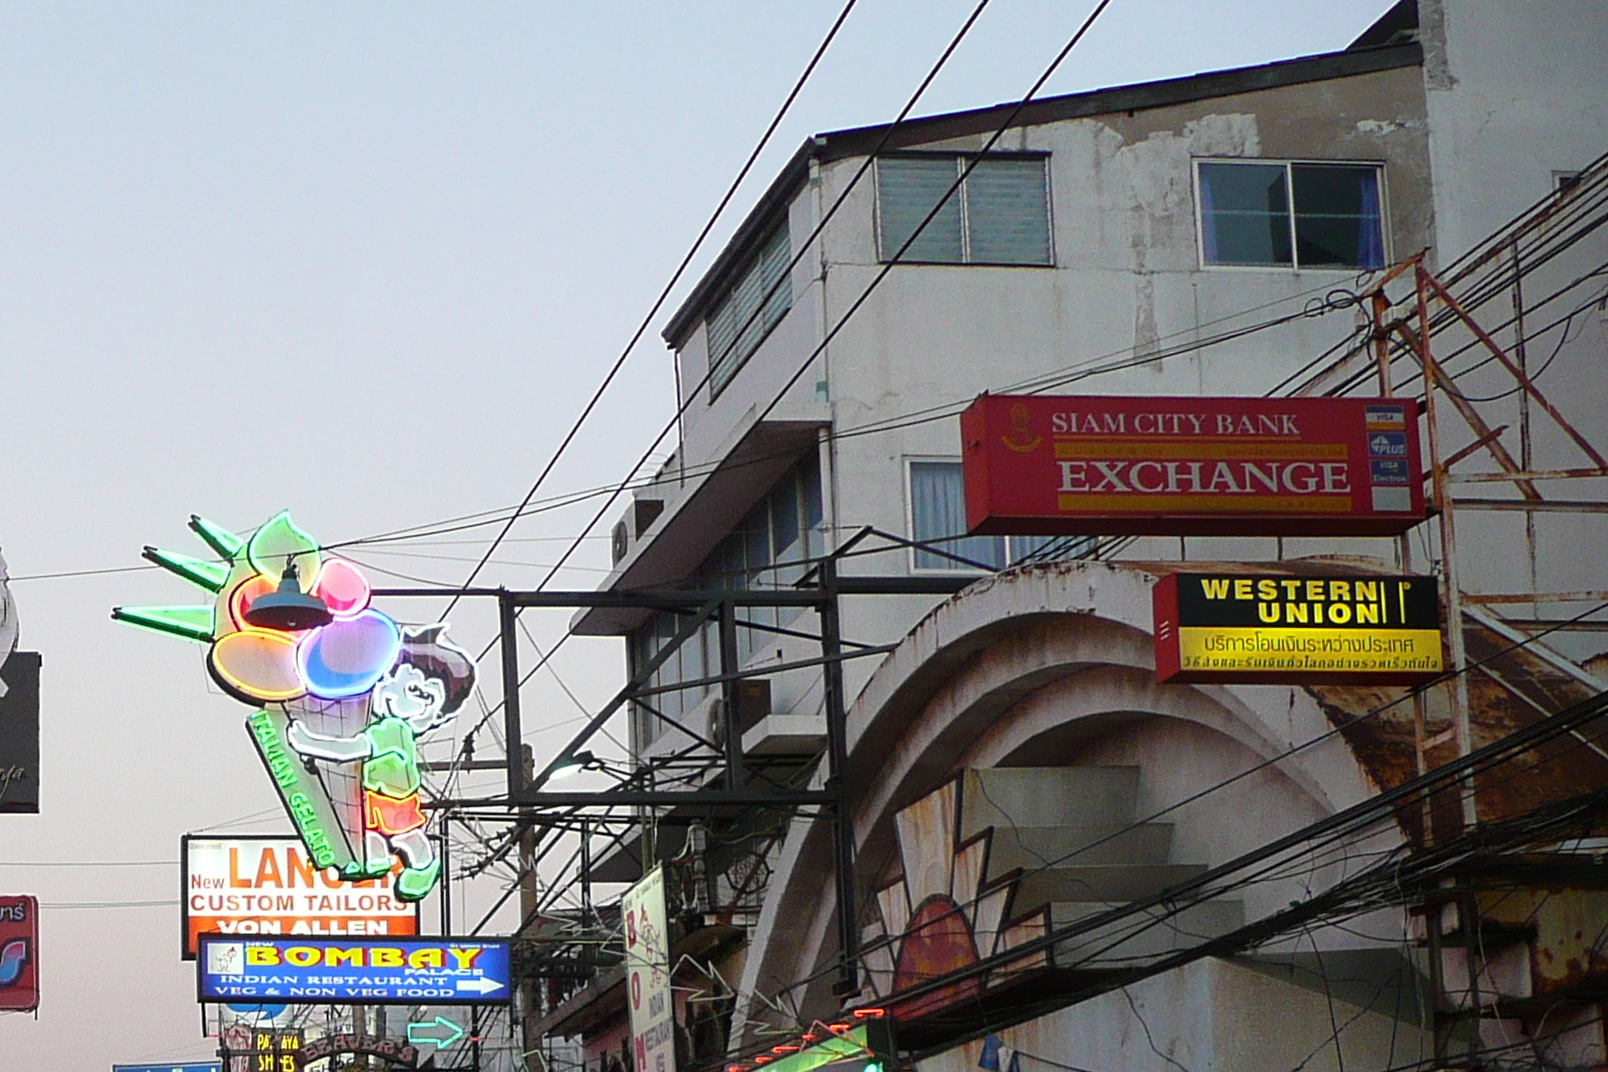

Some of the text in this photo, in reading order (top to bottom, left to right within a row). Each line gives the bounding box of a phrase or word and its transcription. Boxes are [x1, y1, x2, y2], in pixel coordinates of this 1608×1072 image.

[1052, 413, 1301, 436] SIAM CITY BANK
[1379, 445, 1405, 455] PLUS
[1056, 461, 1352, 494] EXCHANGE
[1200, 579, 1379, 601] WESTERN
[1257, 602, 1380, 624] UNION
[250, 709, 334, 869] ITALIAN GELATO
[191, 874, 224, 889] New
[190, 895, 408, 912] CUSTOM TAILORS
[216, 920, 388, 935] VON ALLEN
[245, 946, 481, 970] BOMBAY
[220, 975, 448, 985] INDIAN RESTAURANT
[404, 968, 484, 976] PALACE
[215, 987, 455, 997] VEG & NON VEG FOOD
